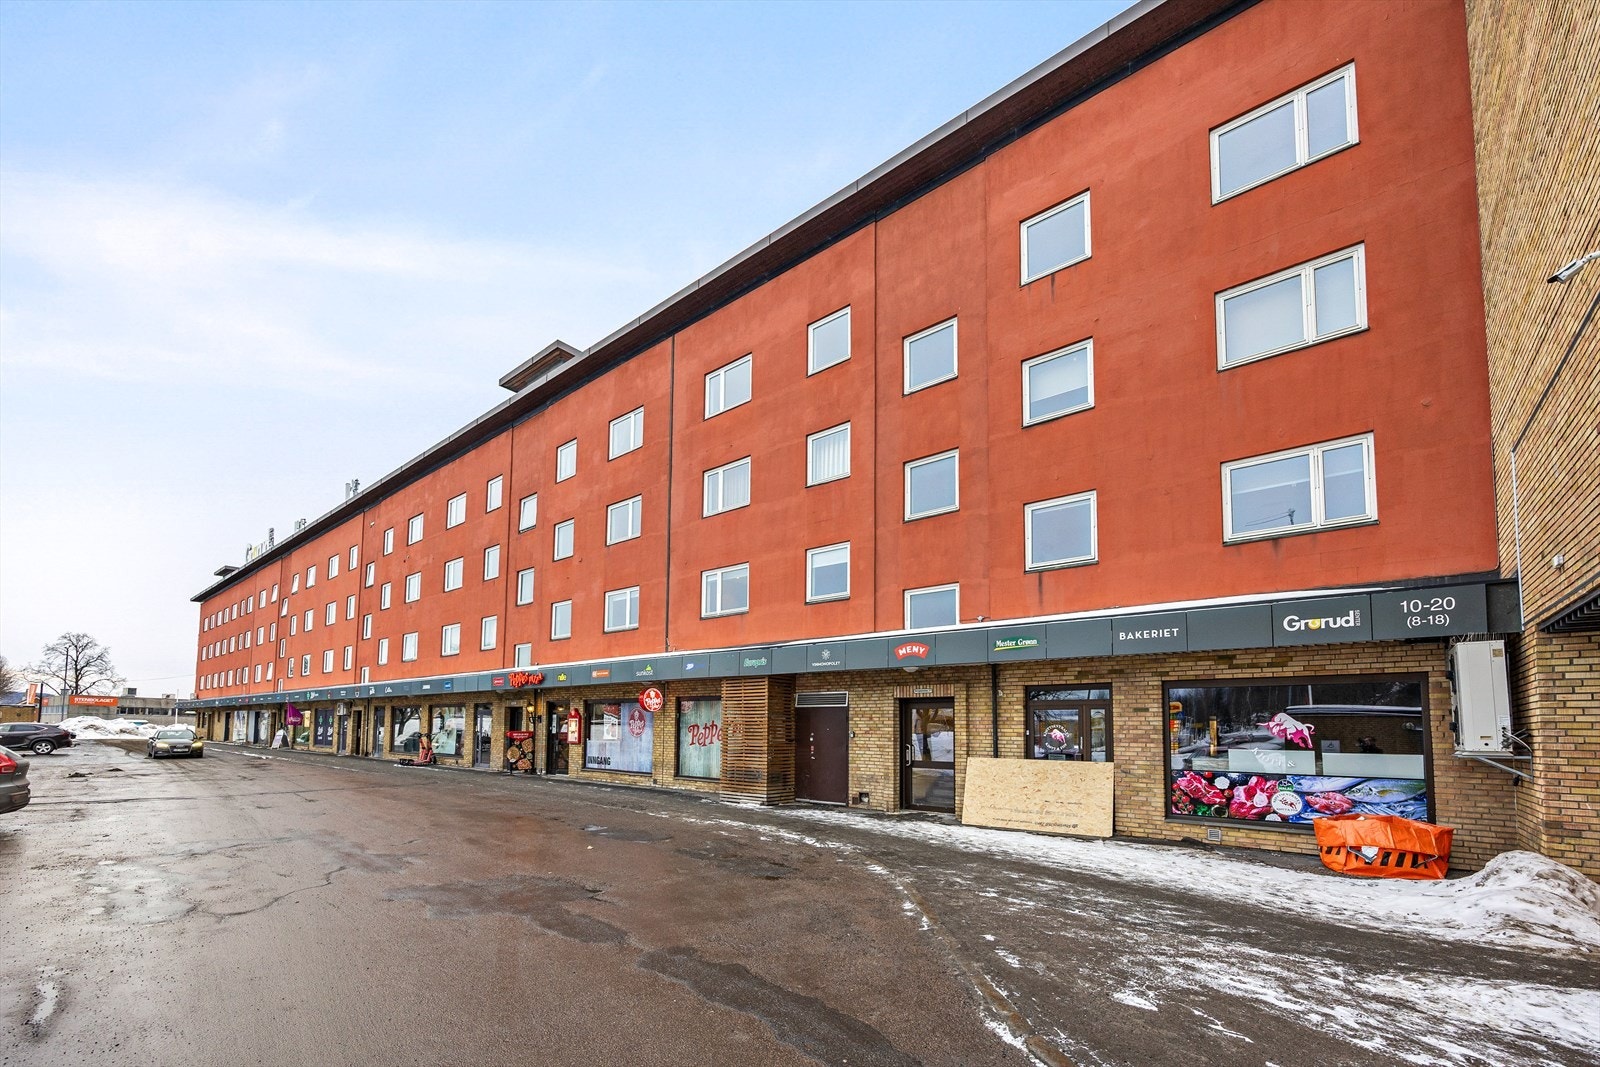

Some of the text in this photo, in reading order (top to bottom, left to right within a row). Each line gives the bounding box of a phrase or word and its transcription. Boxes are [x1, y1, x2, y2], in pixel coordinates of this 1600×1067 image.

[1400, 597, 1456, 613] 10-20
[1406, 614, 1450, 629] (8-18)
[1119, 628, 1179, 641] BAKERIET
[995, 640, 1016, 648] Mester
[898, 645, 925, 656] MENY
[588, 756, 611, 766] INNGANG
